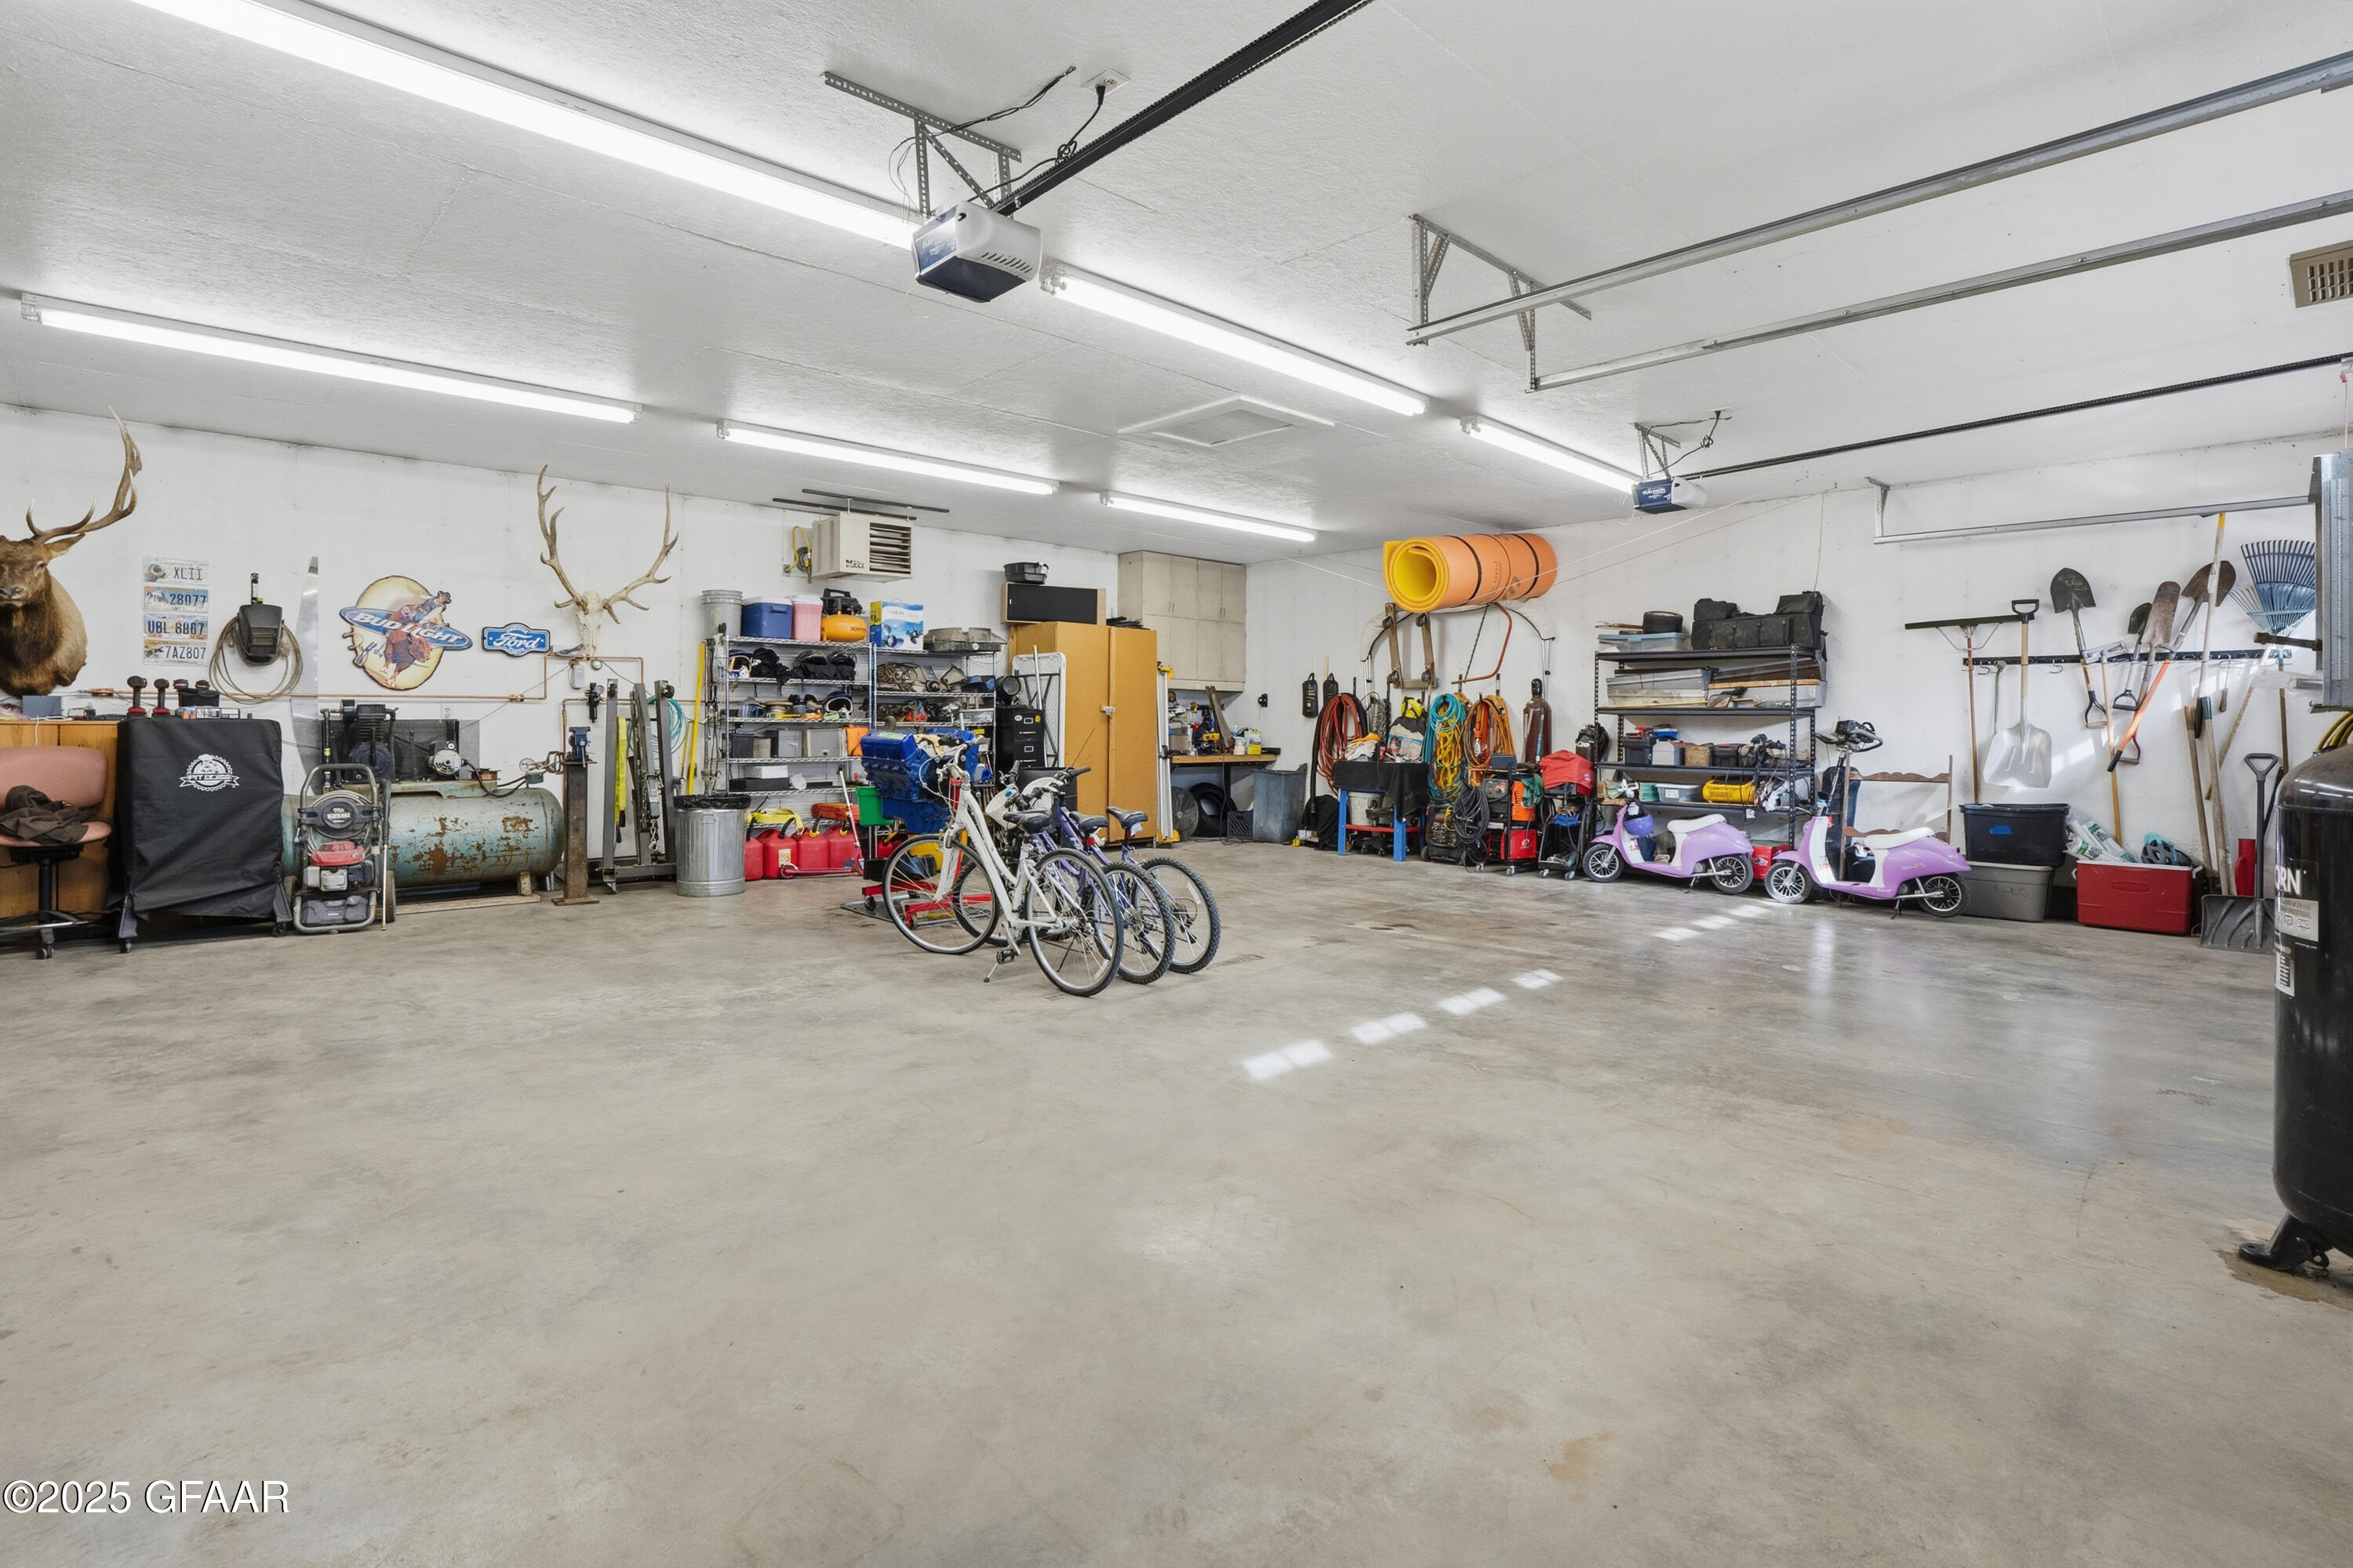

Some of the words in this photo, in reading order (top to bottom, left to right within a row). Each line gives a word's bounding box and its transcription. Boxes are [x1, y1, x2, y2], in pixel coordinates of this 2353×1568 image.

[173, 566, 202, 580] XLII
[169, 593, 206, 606] 28077
[147, 620, 170, 634] UBL
[353, 612, 402, 630] BUD
[403, 623, 463, 644] LIGHT
[493, 632, 541, 649] Ford
[165, 646, 206, 660] 7AZ807
